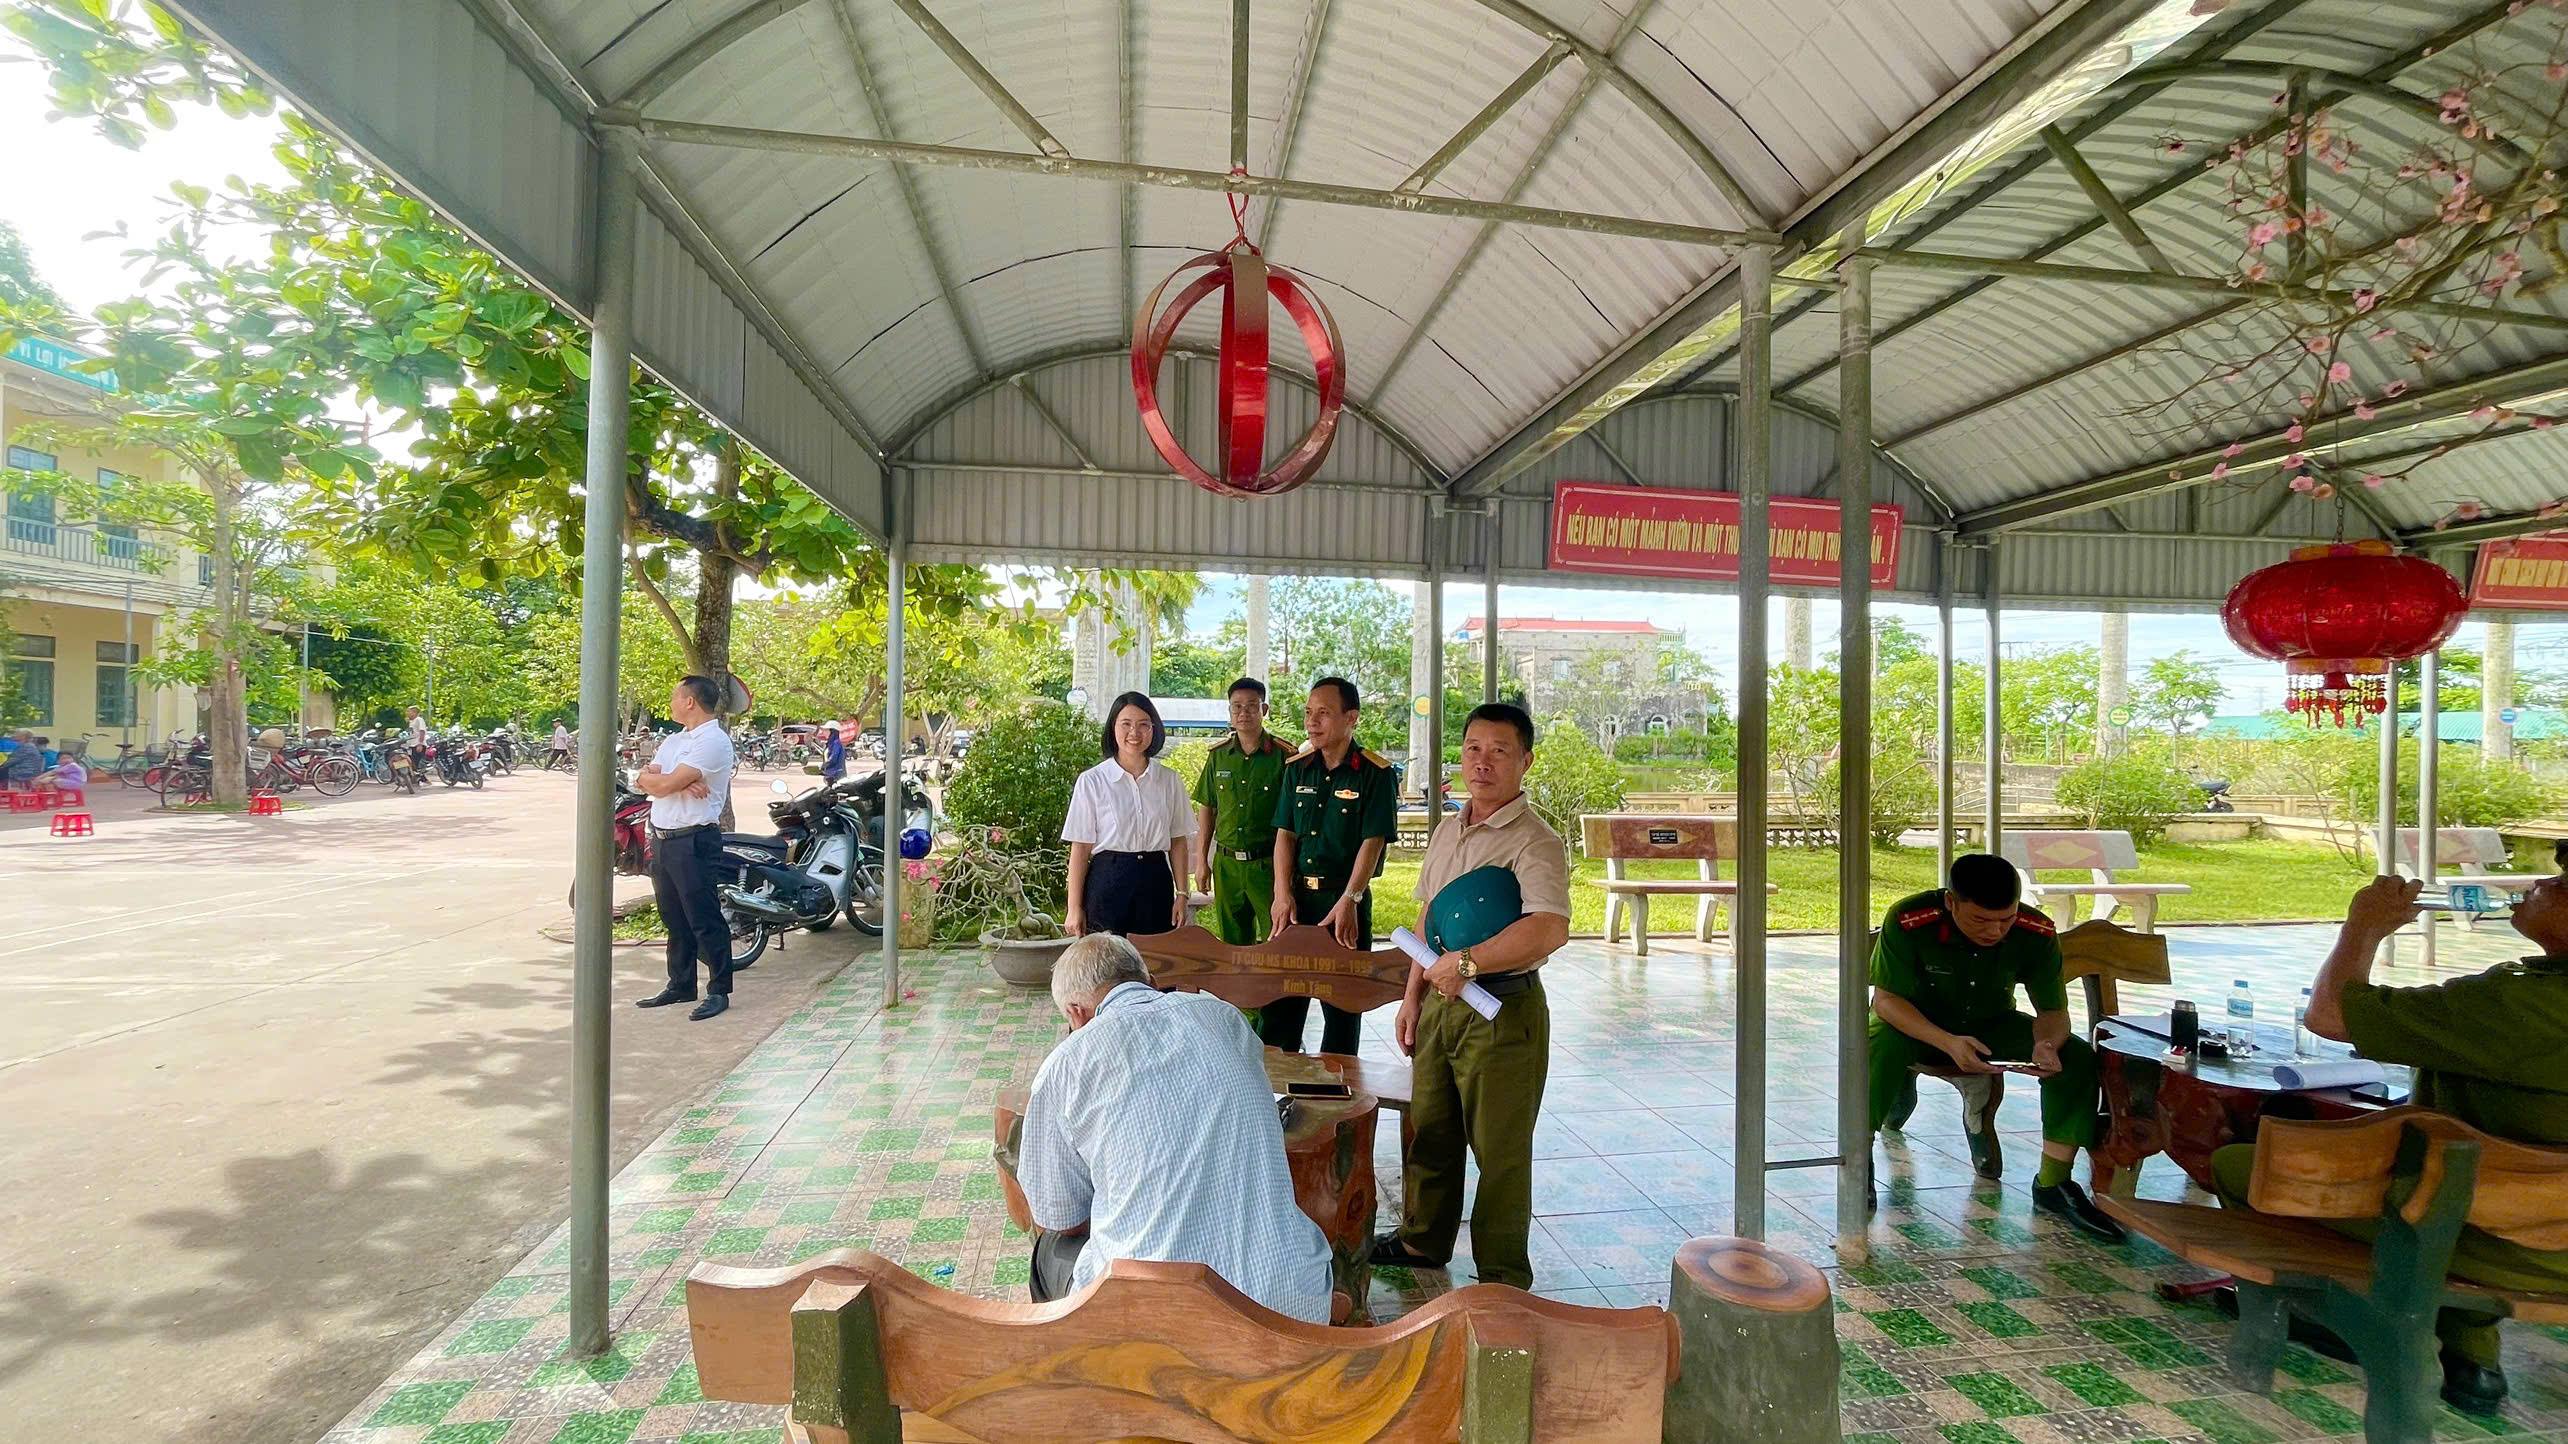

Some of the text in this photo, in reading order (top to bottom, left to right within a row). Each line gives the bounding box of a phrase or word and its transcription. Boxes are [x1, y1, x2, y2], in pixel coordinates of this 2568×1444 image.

[1566, 503, 1586, 546] NẾU
[1586, 515, 1606, 553] BẠN
[1606, 510, 1620, 548] CÓ
[1619, 511, 1640, 556] MỘT
[1691, 516, 1703, 553] VÀ
[1703, 517, 1724, 560] MỘT
[1775, 528, 1795, 565] BẠN
[1794, 523, 1808, 559] CÓ
[1313, 957, 1337, 972] 1991
